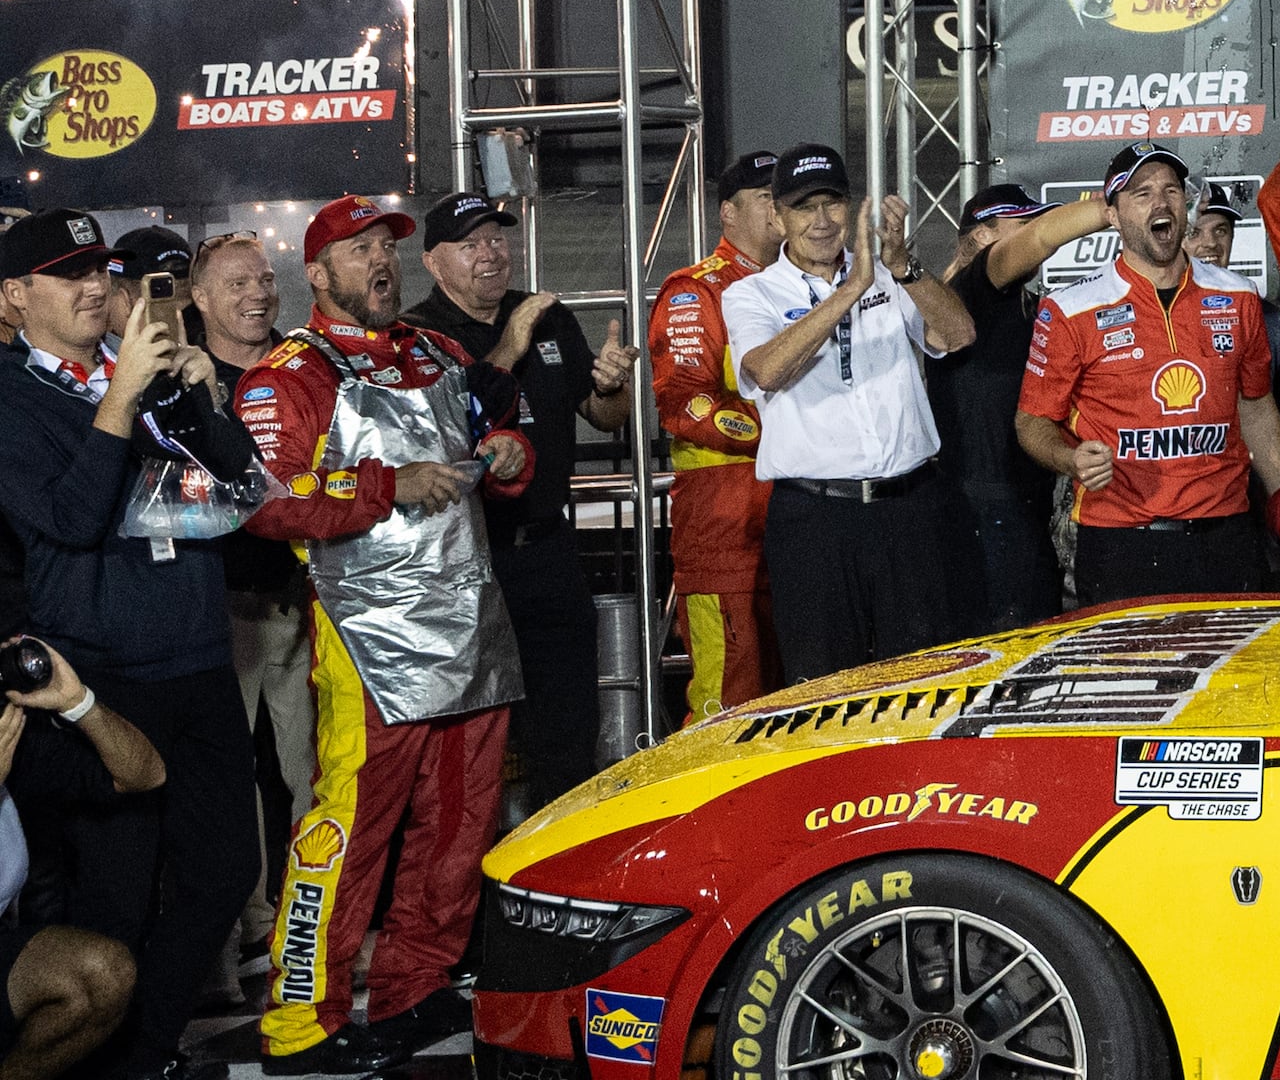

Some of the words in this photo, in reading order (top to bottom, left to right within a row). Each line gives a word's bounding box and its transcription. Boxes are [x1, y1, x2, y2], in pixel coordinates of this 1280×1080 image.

[61, 54, 122, 87] Bass
[201, 56, 380, 97] TRACKER
[67, 85, 110, 114] Pro
[1062, 70, 1248, 111] TRACKER
[188, 100, 286, 126] BOATS
[311, 95, 384, 120] ATVs
[1048, 111, 1150, 138] BOATS
[1156, 115, 1171, 134] &
[1177, 110, 1252, 134] ATVs
[63, 111, 140, 147] Shops
[792, 162, 832, 176] PENSKE
[799, 156, 828, 167] TEAM
[1213, 335, 1233, 351] PPG
[718, 415, 755, 435] PENNZOIL
[1118, 422, 1229, 461] PENNZOIL
[1165, 742, 1242, 763] NASCAR
[1135, 772, 1175, 790] CUP
[1177, 770, 1241, 789] SERIES
[804, 781, 1041, 832] GOODYEAR
[1181, 803, 1205, 817] THE
[1207, 802, 1250, 816] CHASE
[280, 880, 324, 1003] PENNZOIL
[591, 1014, 658, 1041] SUNOCO
